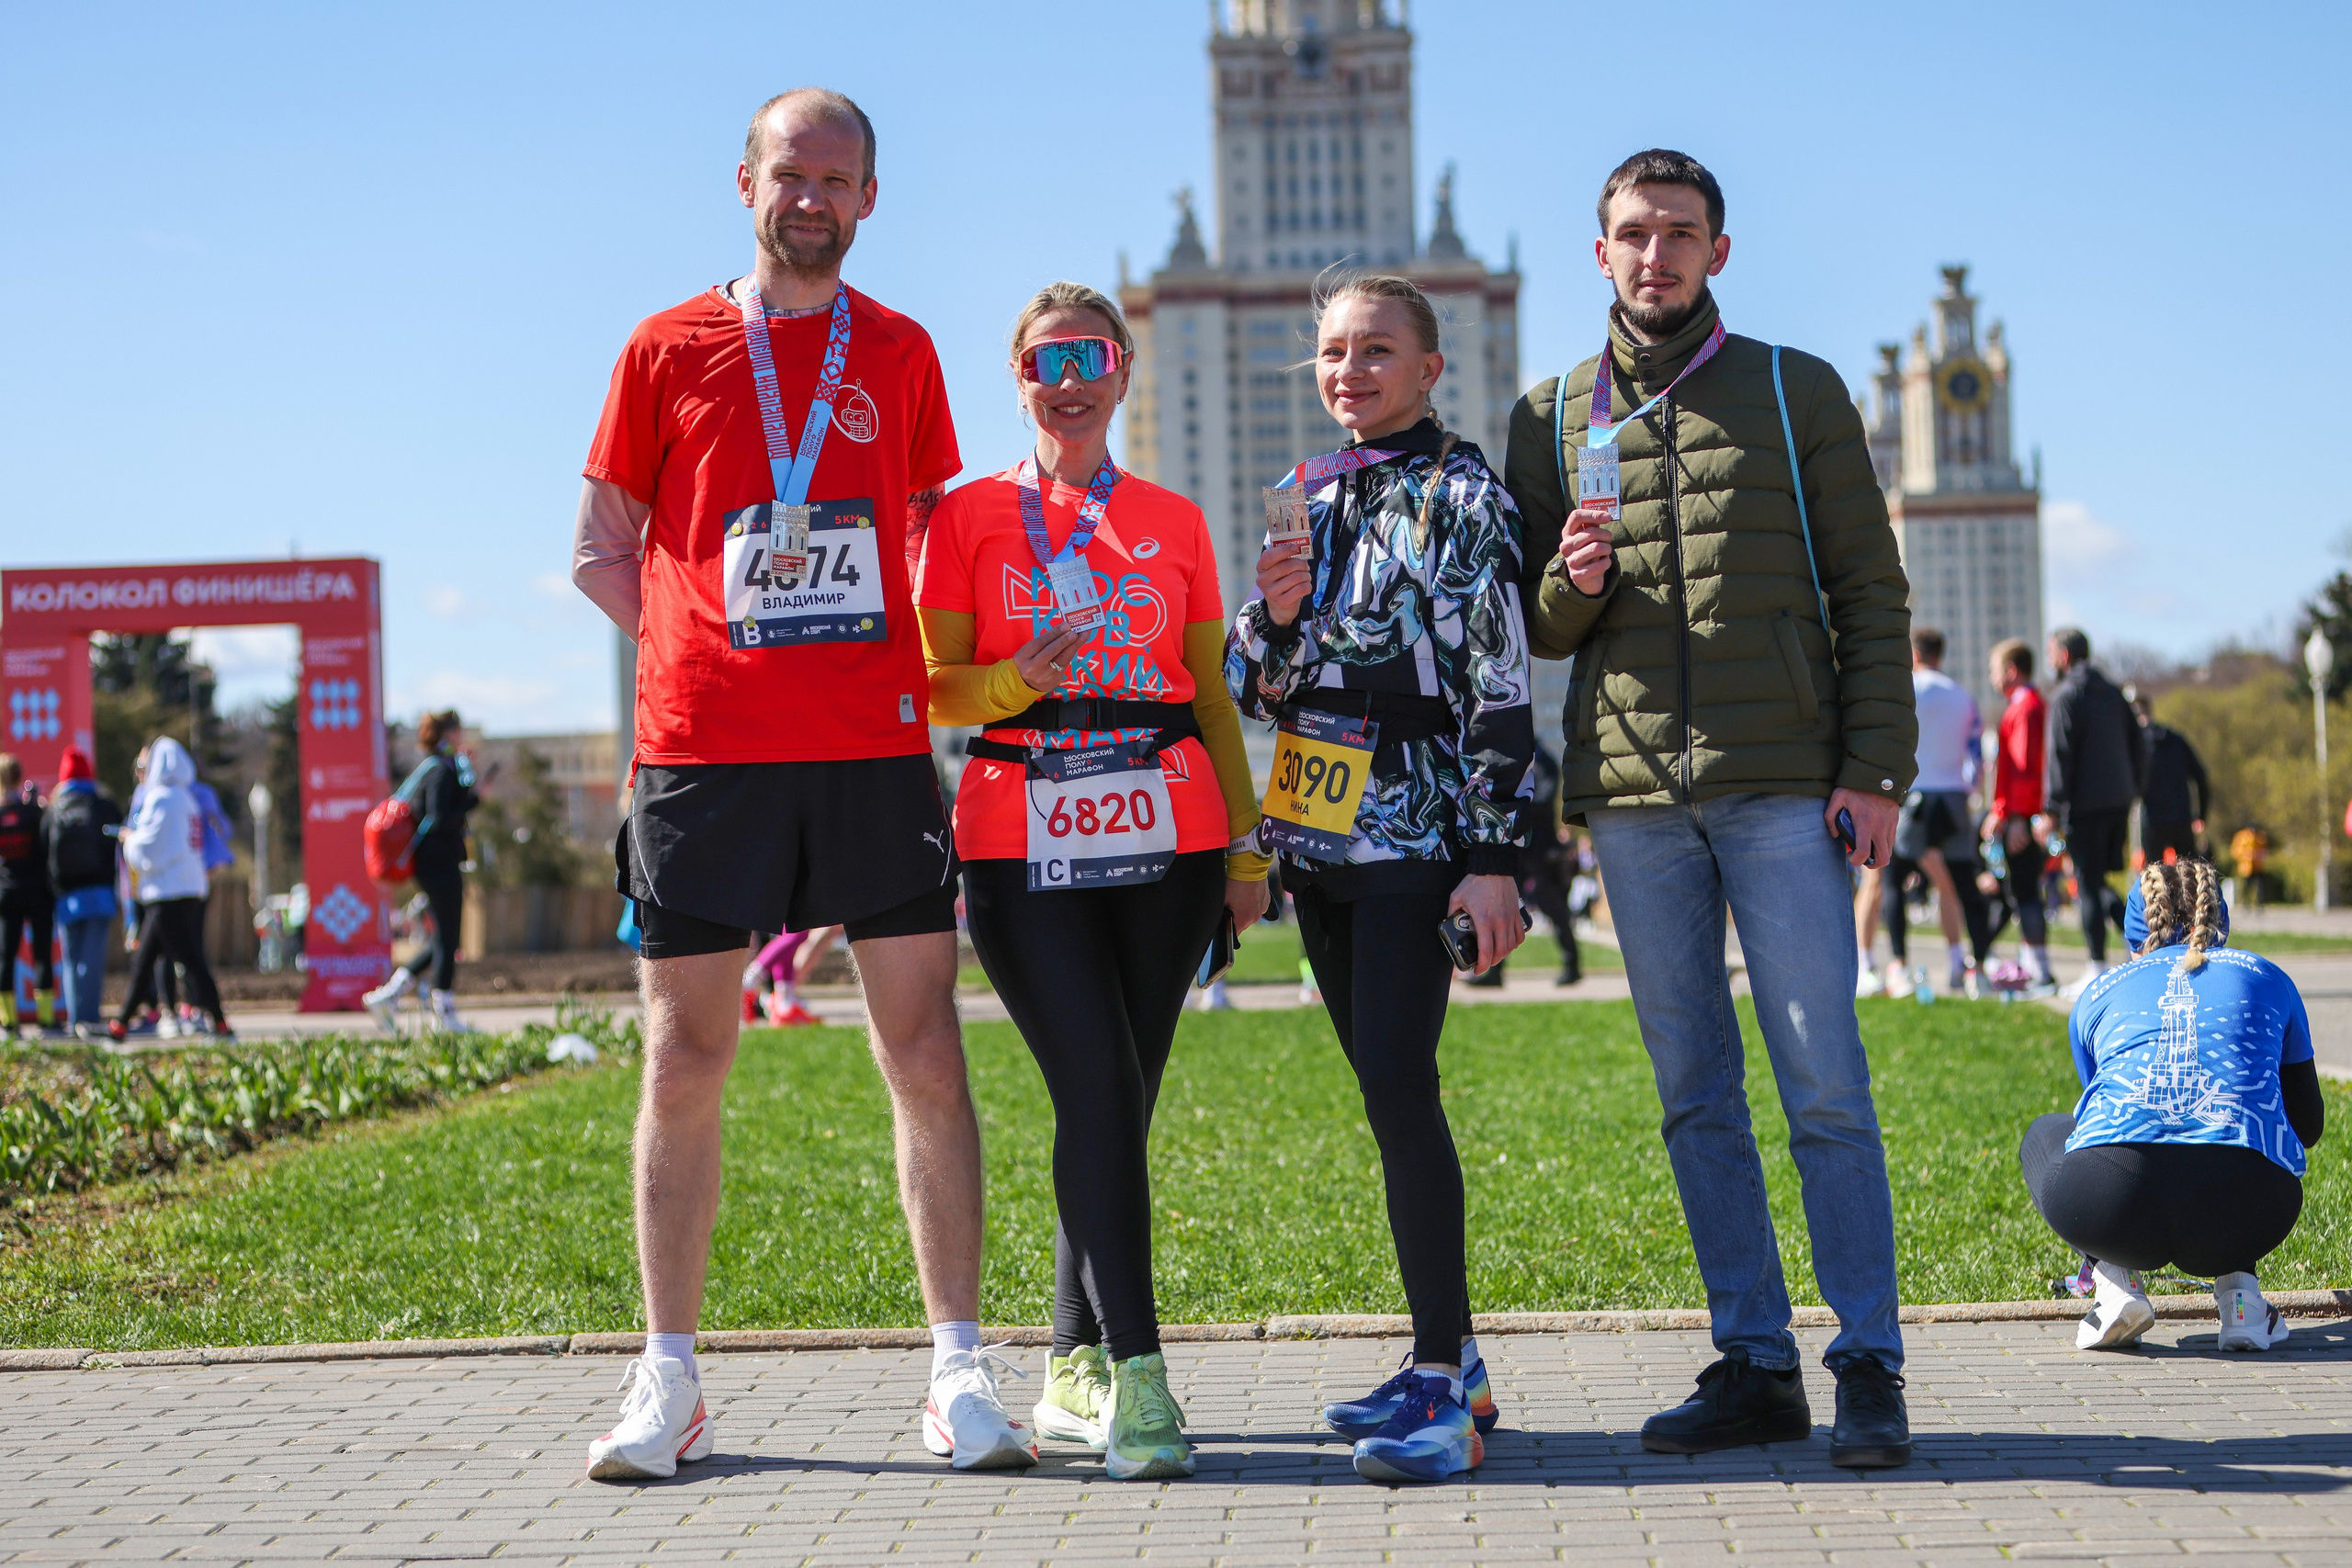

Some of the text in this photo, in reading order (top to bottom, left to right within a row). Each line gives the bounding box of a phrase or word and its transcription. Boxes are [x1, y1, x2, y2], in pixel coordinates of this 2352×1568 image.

[799, 410, 818, 457] МОСКОВСКИЙ
[811, 426, 825, 460] МАРАФОН
[834, 515, 842, 525] 5
[10, 566, 357, 614] КОЛОКОЛ ФИНИШЁРА
[762, 592, 846, 610] ВЛАДИМИР
[1298, 711, 1336, 725] МОСКОВСКИЙ
[1296, 726, 1321, 737] МАРАФОН
[1341, 732, 1348, 742] 5
[1063, 747, 1114, 763] МОСКОВСКИЙ
[1127, 757, 1134, 766] 5
[1065, 761, 1086, 770] ПОЛУ
[1066, 763, 1104, 776] МАРАФОН
[1278, 749, 1351, 805] 3090
[1046, 788, 1156, 838] 6820
[1290, 799, 1309, 816] НИНА
